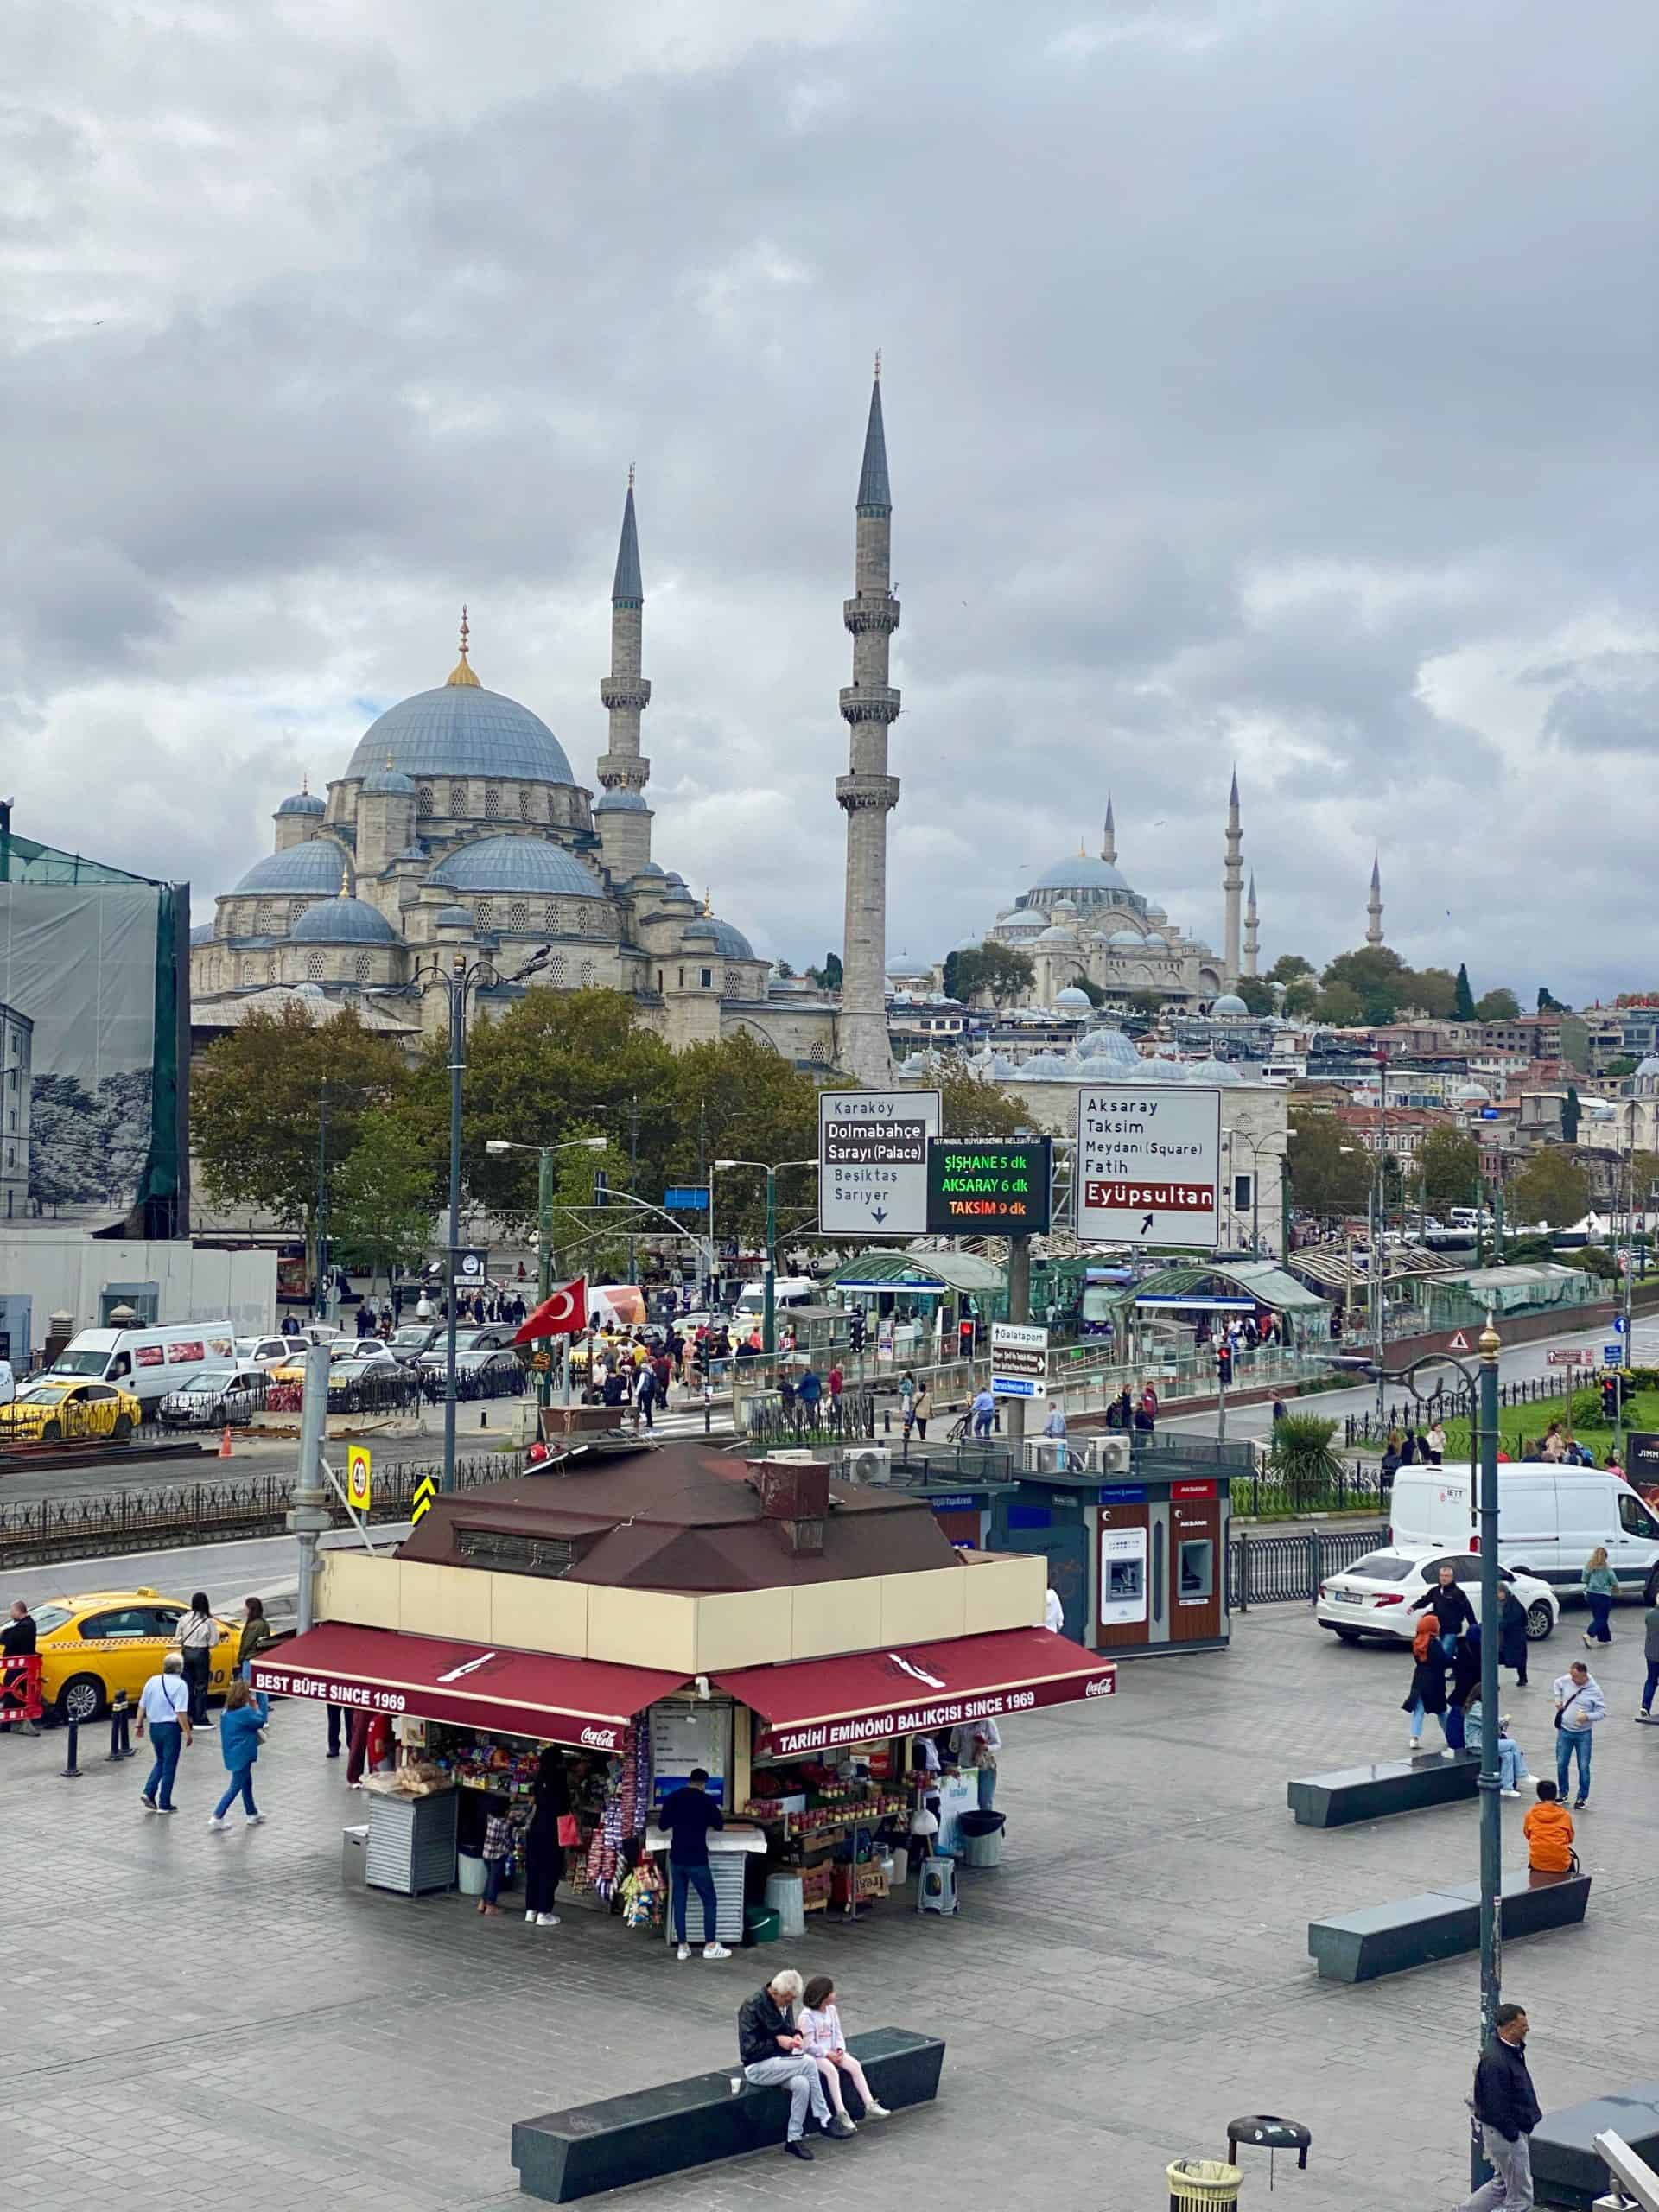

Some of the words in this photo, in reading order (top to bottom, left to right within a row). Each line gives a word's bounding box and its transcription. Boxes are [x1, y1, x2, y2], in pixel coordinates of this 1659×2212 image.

[835, 1101, 894, 1116] Karaköy
[1087, 1098, 1158, 1116] Aksaray
[829, 1123, 920, 1139] Dolmabahçe
[1087, 1119, 1143, 1134] Taksim
[829, 1145, 871, 1162] Sarayı
[874, 1144, 921, 1160] (Palace)
[1085, 1141, 1142, 1155] Meydanı
[1146, 1142, 1203, 1156] (Square)
[944, 1154, 998, 1173] ŞİŞHANE
[1001, 1157, 1008, 1169] 5
[1010, 1155, 1027, 1169] dk
[1085, 1160, 1128, 1173] Fatih
[835, 1169, 898, 1182] Beşiktaş
[942, 1179, 998, 1192] AKSARAY
[1001, 1179, 1009, 1192] 6
[1012, 1179, 1028, 1192] dk
[835, 1187, 889, 1205] Sarıyer
[1088, 1184, 1213, 1207] Eyüpsultan
[949, 1200, 996, 1214] TAKSİM
[999, 1202, 1007, 1214] 9
[1009, 1202, 1027, 1215] dk
[1001, 1329, 1044, 1343] Galataport
[256, 1673, 289, 1691] BEST
[292, 1678, 327, 1698] BÜFE
[329, 1684, 370, 1705] SINCE
[374, 1692, 405, 1711] 1969
[1085, 1678, 1112, 1697] Coca-Cola
[780, 1726, 826, 1751] TARİHİ
[830, 1715, 893, 1743] EMİNÖNÜ
[898, 1703, 962, 1729] BALIKÇISI
[965, 1698, 1002, 1718] SINCE
[1006, 1691, 1035, 1709] 1969
[581, 1726, 617, 1747] Coca-Cola
